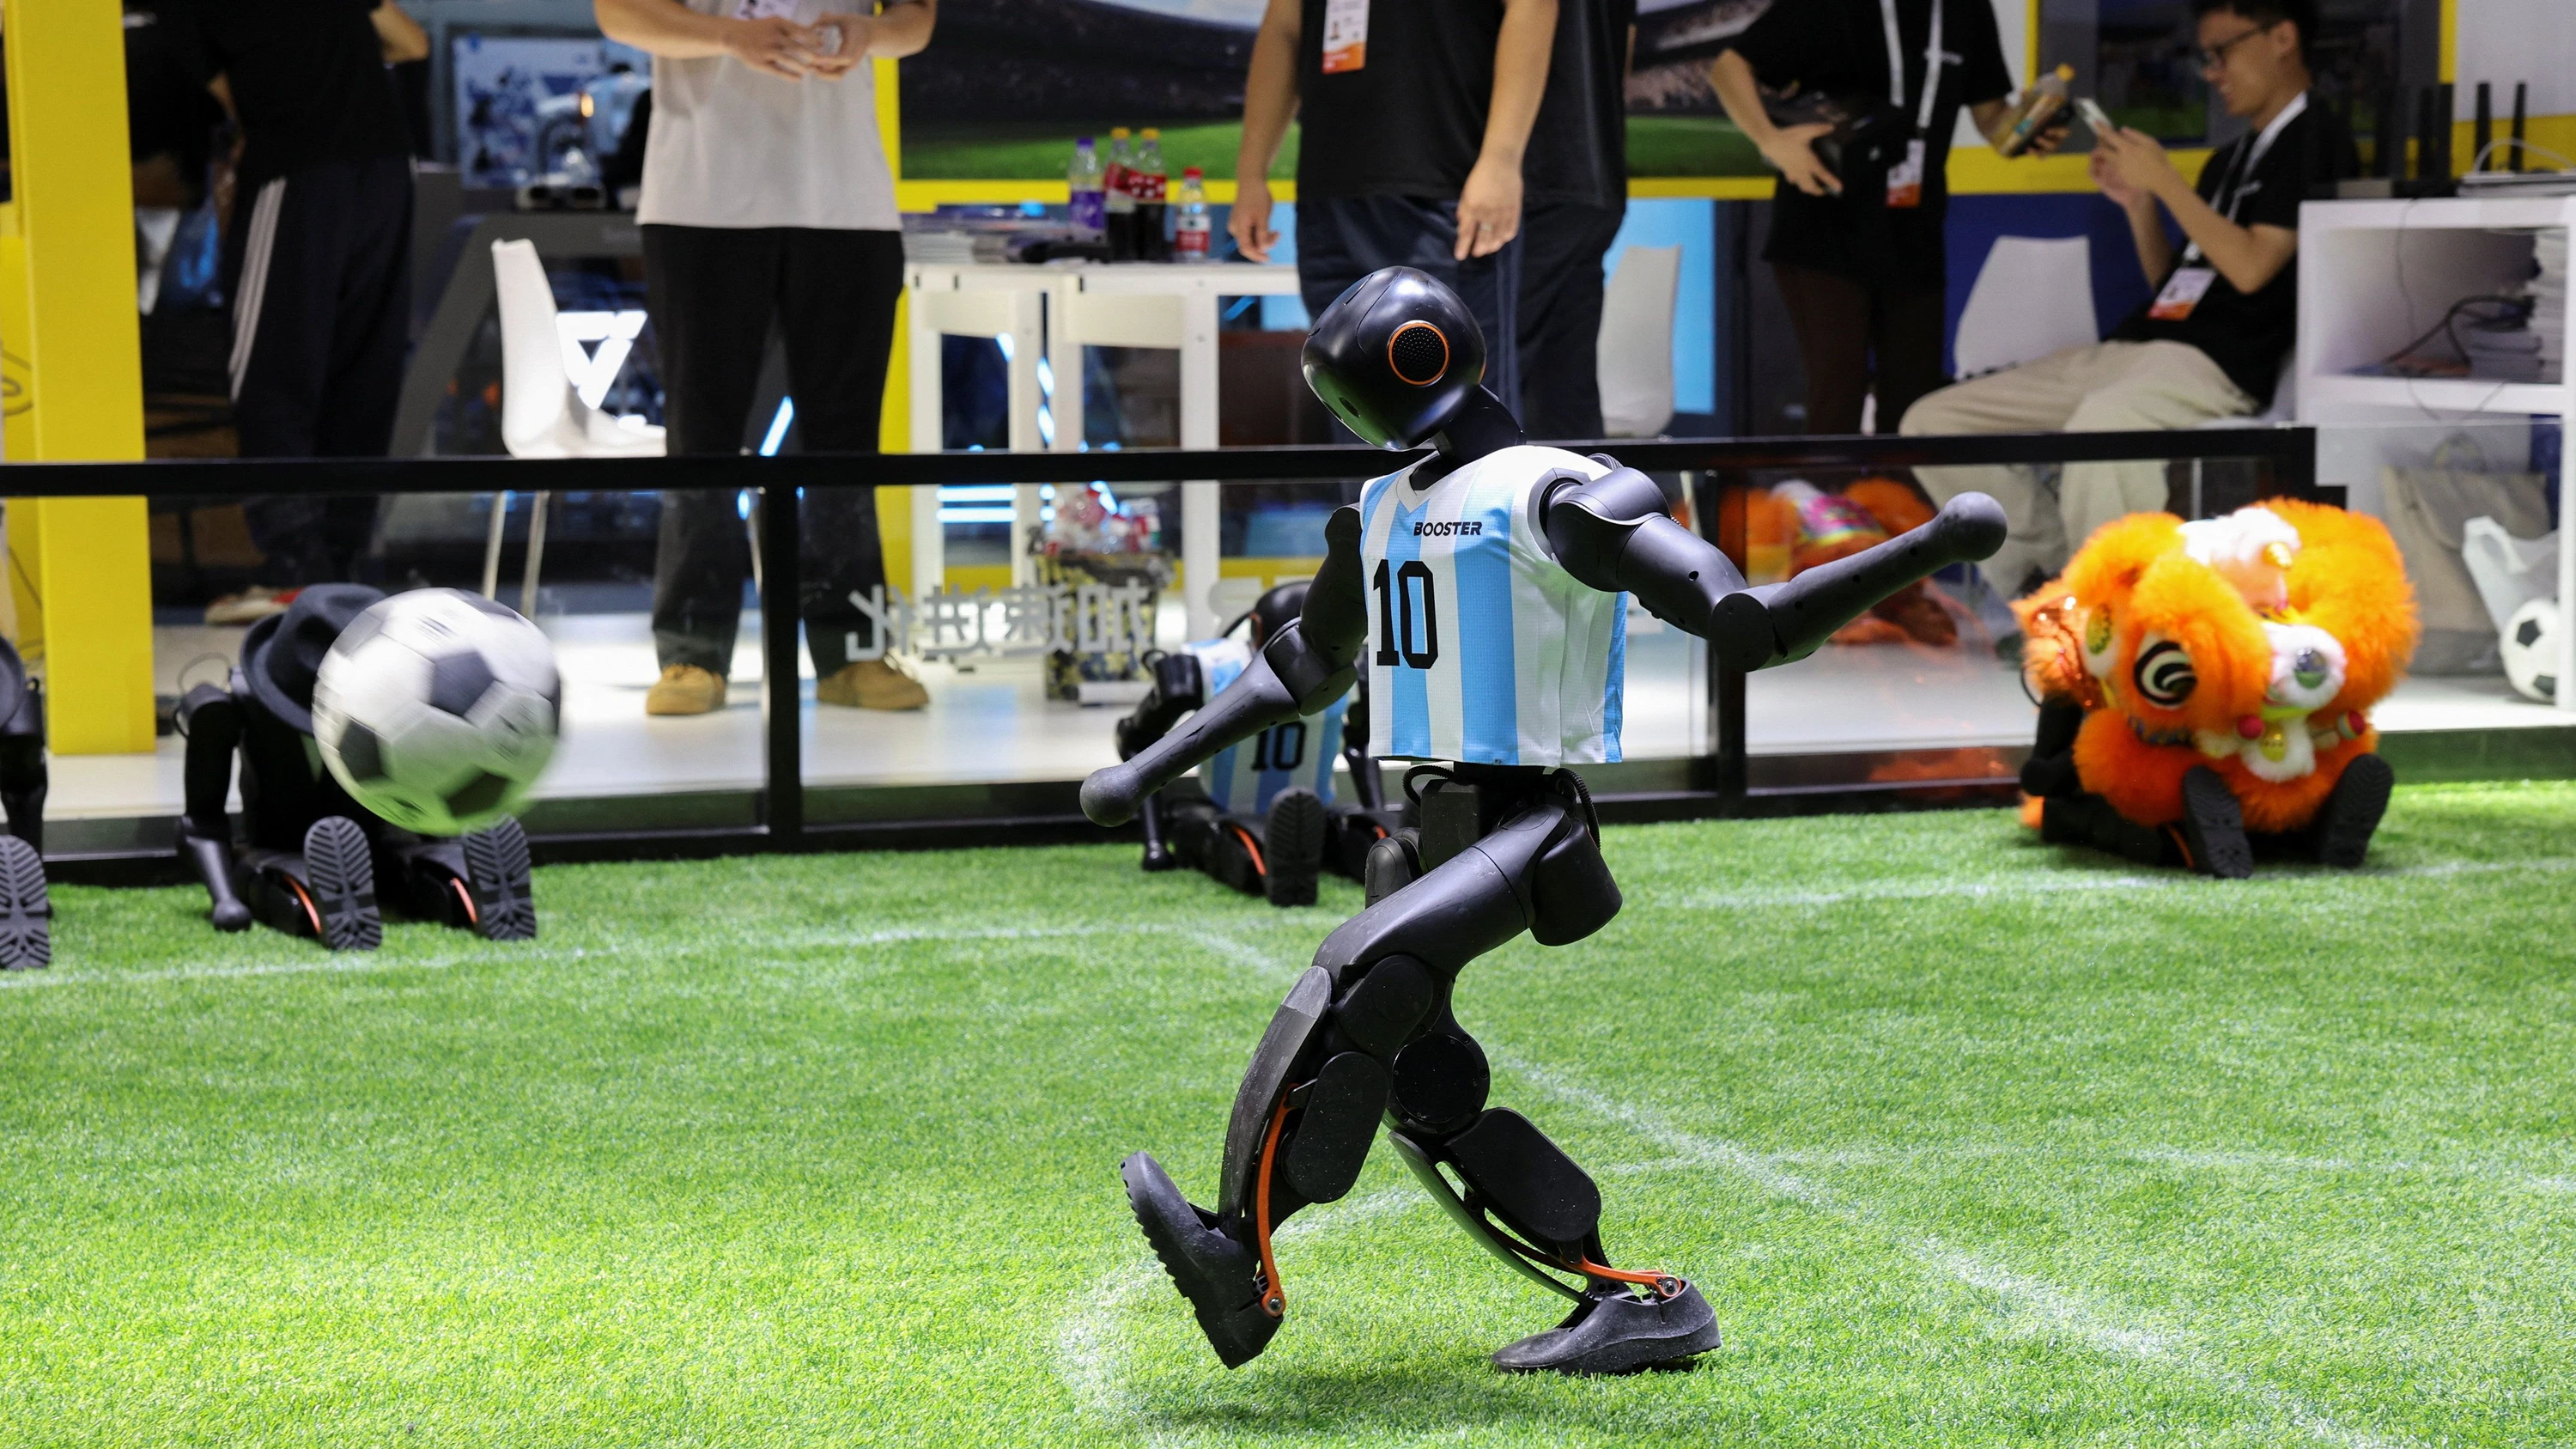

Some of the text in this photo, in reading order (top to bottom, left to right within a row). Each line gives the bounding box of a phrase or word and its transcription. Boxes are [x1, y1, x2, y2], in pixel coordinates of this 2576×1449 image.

[1413, 521, 1482, 536] BOOSTER
[1373, 559, 1438, 669] 10
[1251, 721, 1306, 770] 10
